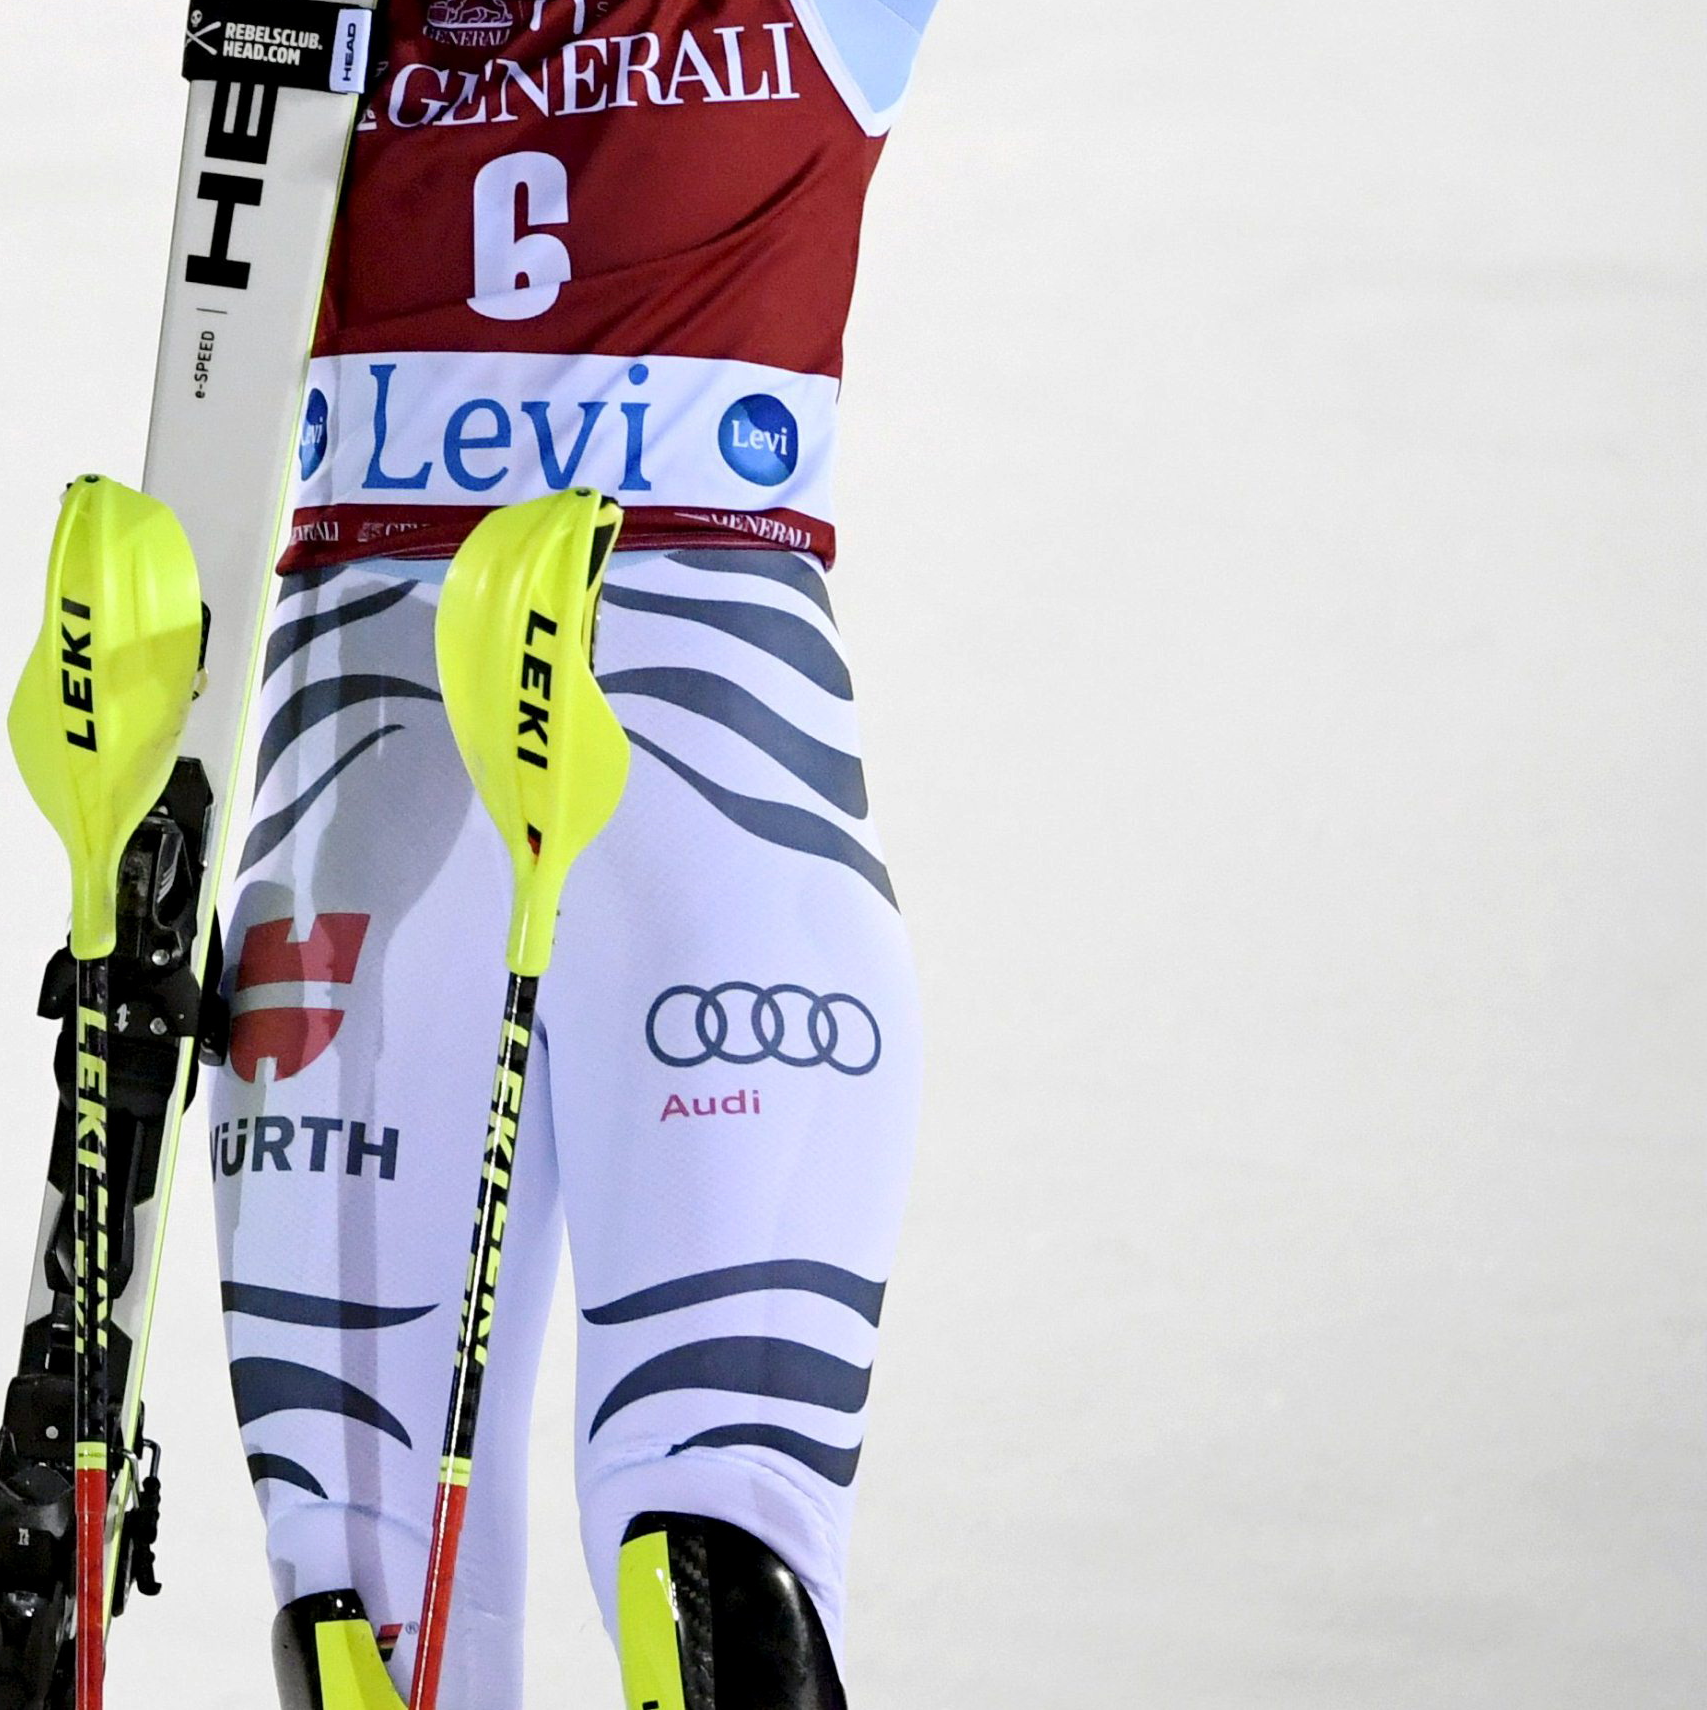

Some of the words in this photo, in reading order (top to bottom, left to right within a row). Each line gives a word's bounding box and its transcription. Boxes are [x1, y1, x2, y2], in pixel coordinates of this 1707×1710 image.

[223, 41, 301, 66] HEAD.COM
[225, 22, 323, 50] REBELSCLUB.
[343, 22, 357, 82] HEAD
[466, 150, 571, 321] 6
[194, 330, 215, 399] e-SPEED
[362, 363, 652, 492] Levi
[732, 421, 789, 455] Levi
[60, 597, 98, 753] LEKI
[517, 608, 557, 772] LEKI
[76, 1005, 107, 1173] LEKI
[481, 1017, 530, 1190] LEKI
[660, 1089, 761, 1122] Audi
